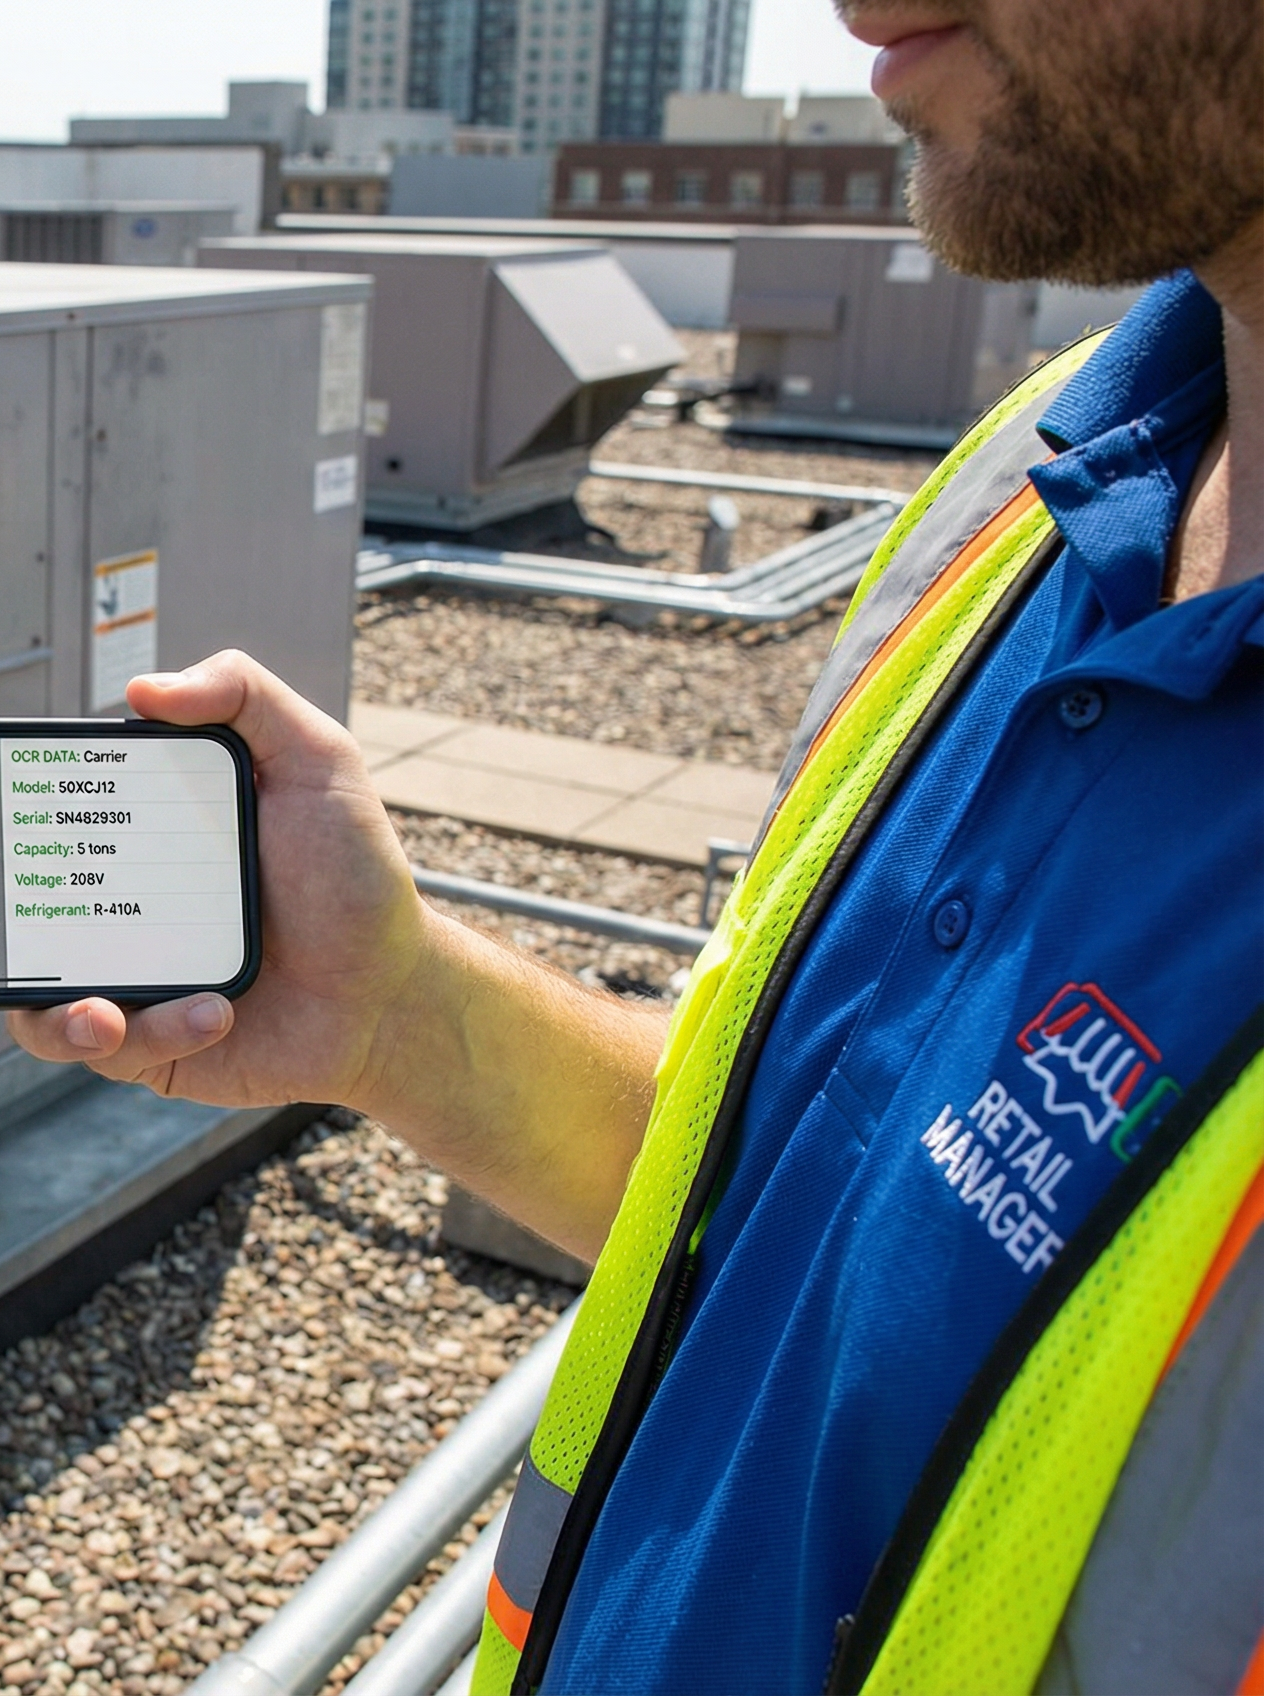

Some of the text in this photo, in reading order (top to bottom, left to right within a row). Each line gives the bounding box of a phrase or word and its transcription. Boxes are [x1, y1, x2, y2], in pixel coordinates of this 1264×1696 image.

[11, 749, 127, 763] OCR DATA: Carrier
[12, 780, 115, 794] Model: 50XCJ12
[13, 811, 131, 824] Serial: SN4829301
[14, 842, 116, 857] Capacity: 5 tons
[15, 872, 104, 888] Voltage: 208V
[15, 903, 141, 919] Refrigerant: R-410A
[967, 1080, 1073, 1213] RETAIL
